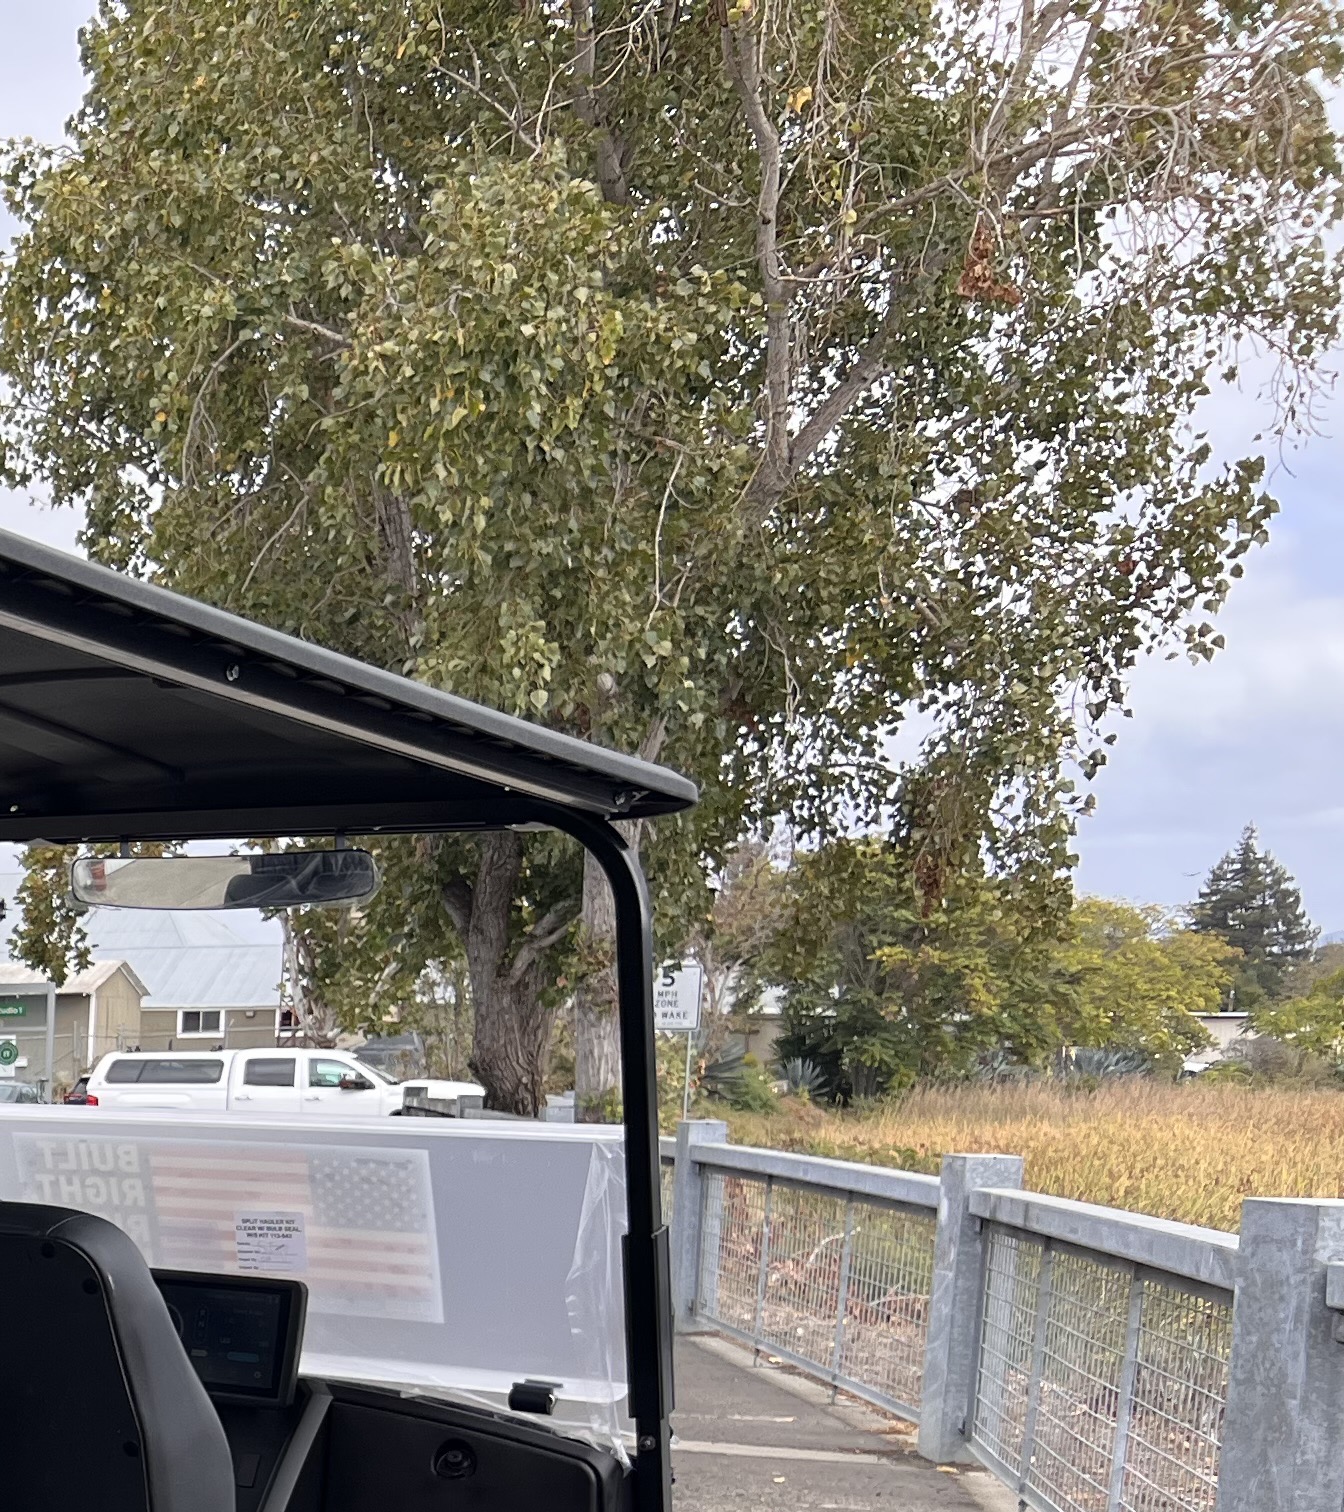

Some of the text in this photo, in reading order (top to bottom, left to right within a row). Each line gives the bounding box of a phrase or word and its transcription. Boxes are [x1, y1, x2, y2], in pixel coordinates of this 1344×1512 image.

[657, 990, 678, 998] MPH
[655, 1000, 678, 1008] ZONE
[662, 1011, 688, 1020] WAKE
